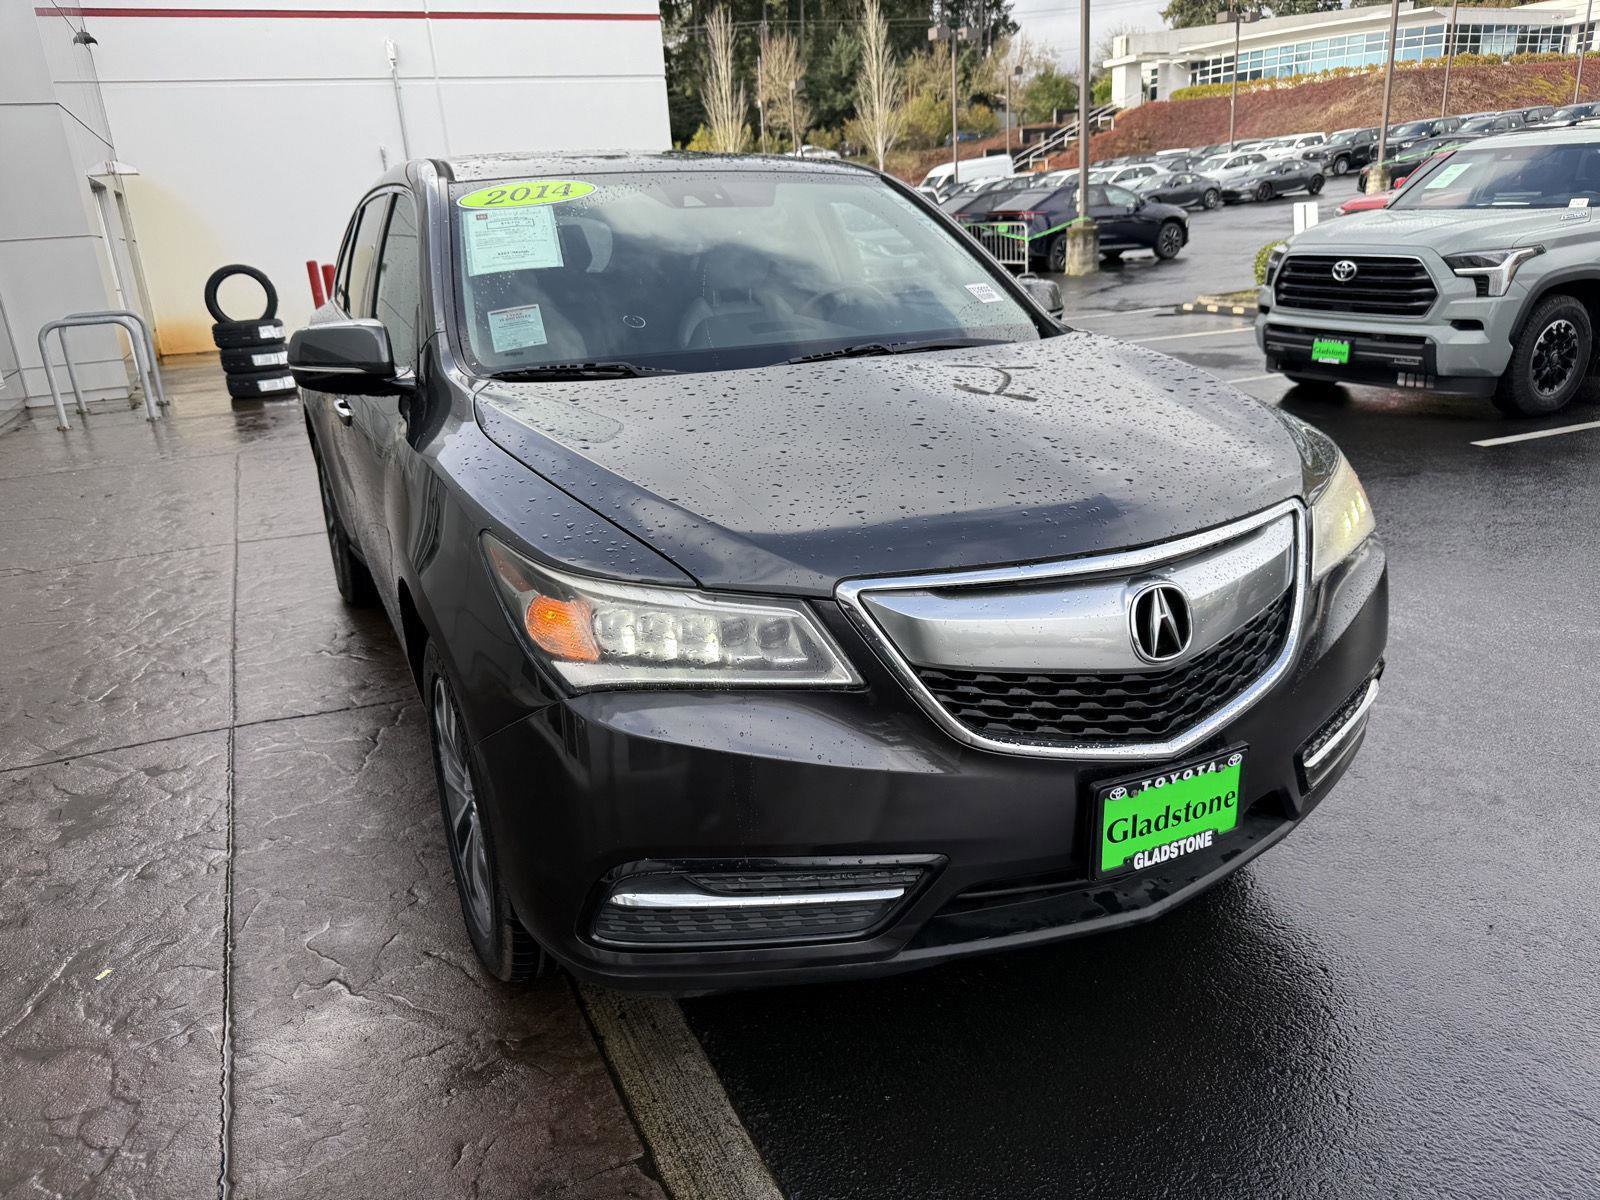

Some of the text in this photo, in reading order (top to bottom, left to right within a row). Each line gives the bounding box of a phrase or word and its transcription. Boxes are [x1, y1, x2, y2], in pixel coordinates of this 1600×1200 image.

[484, 183, 573, 205] 2014
[1142, 762, 1216, 791] TOYOTA
[1106, 790, 1236, 844] Gladstone
[1133, 830, 1213, 870] GLADSTONE
